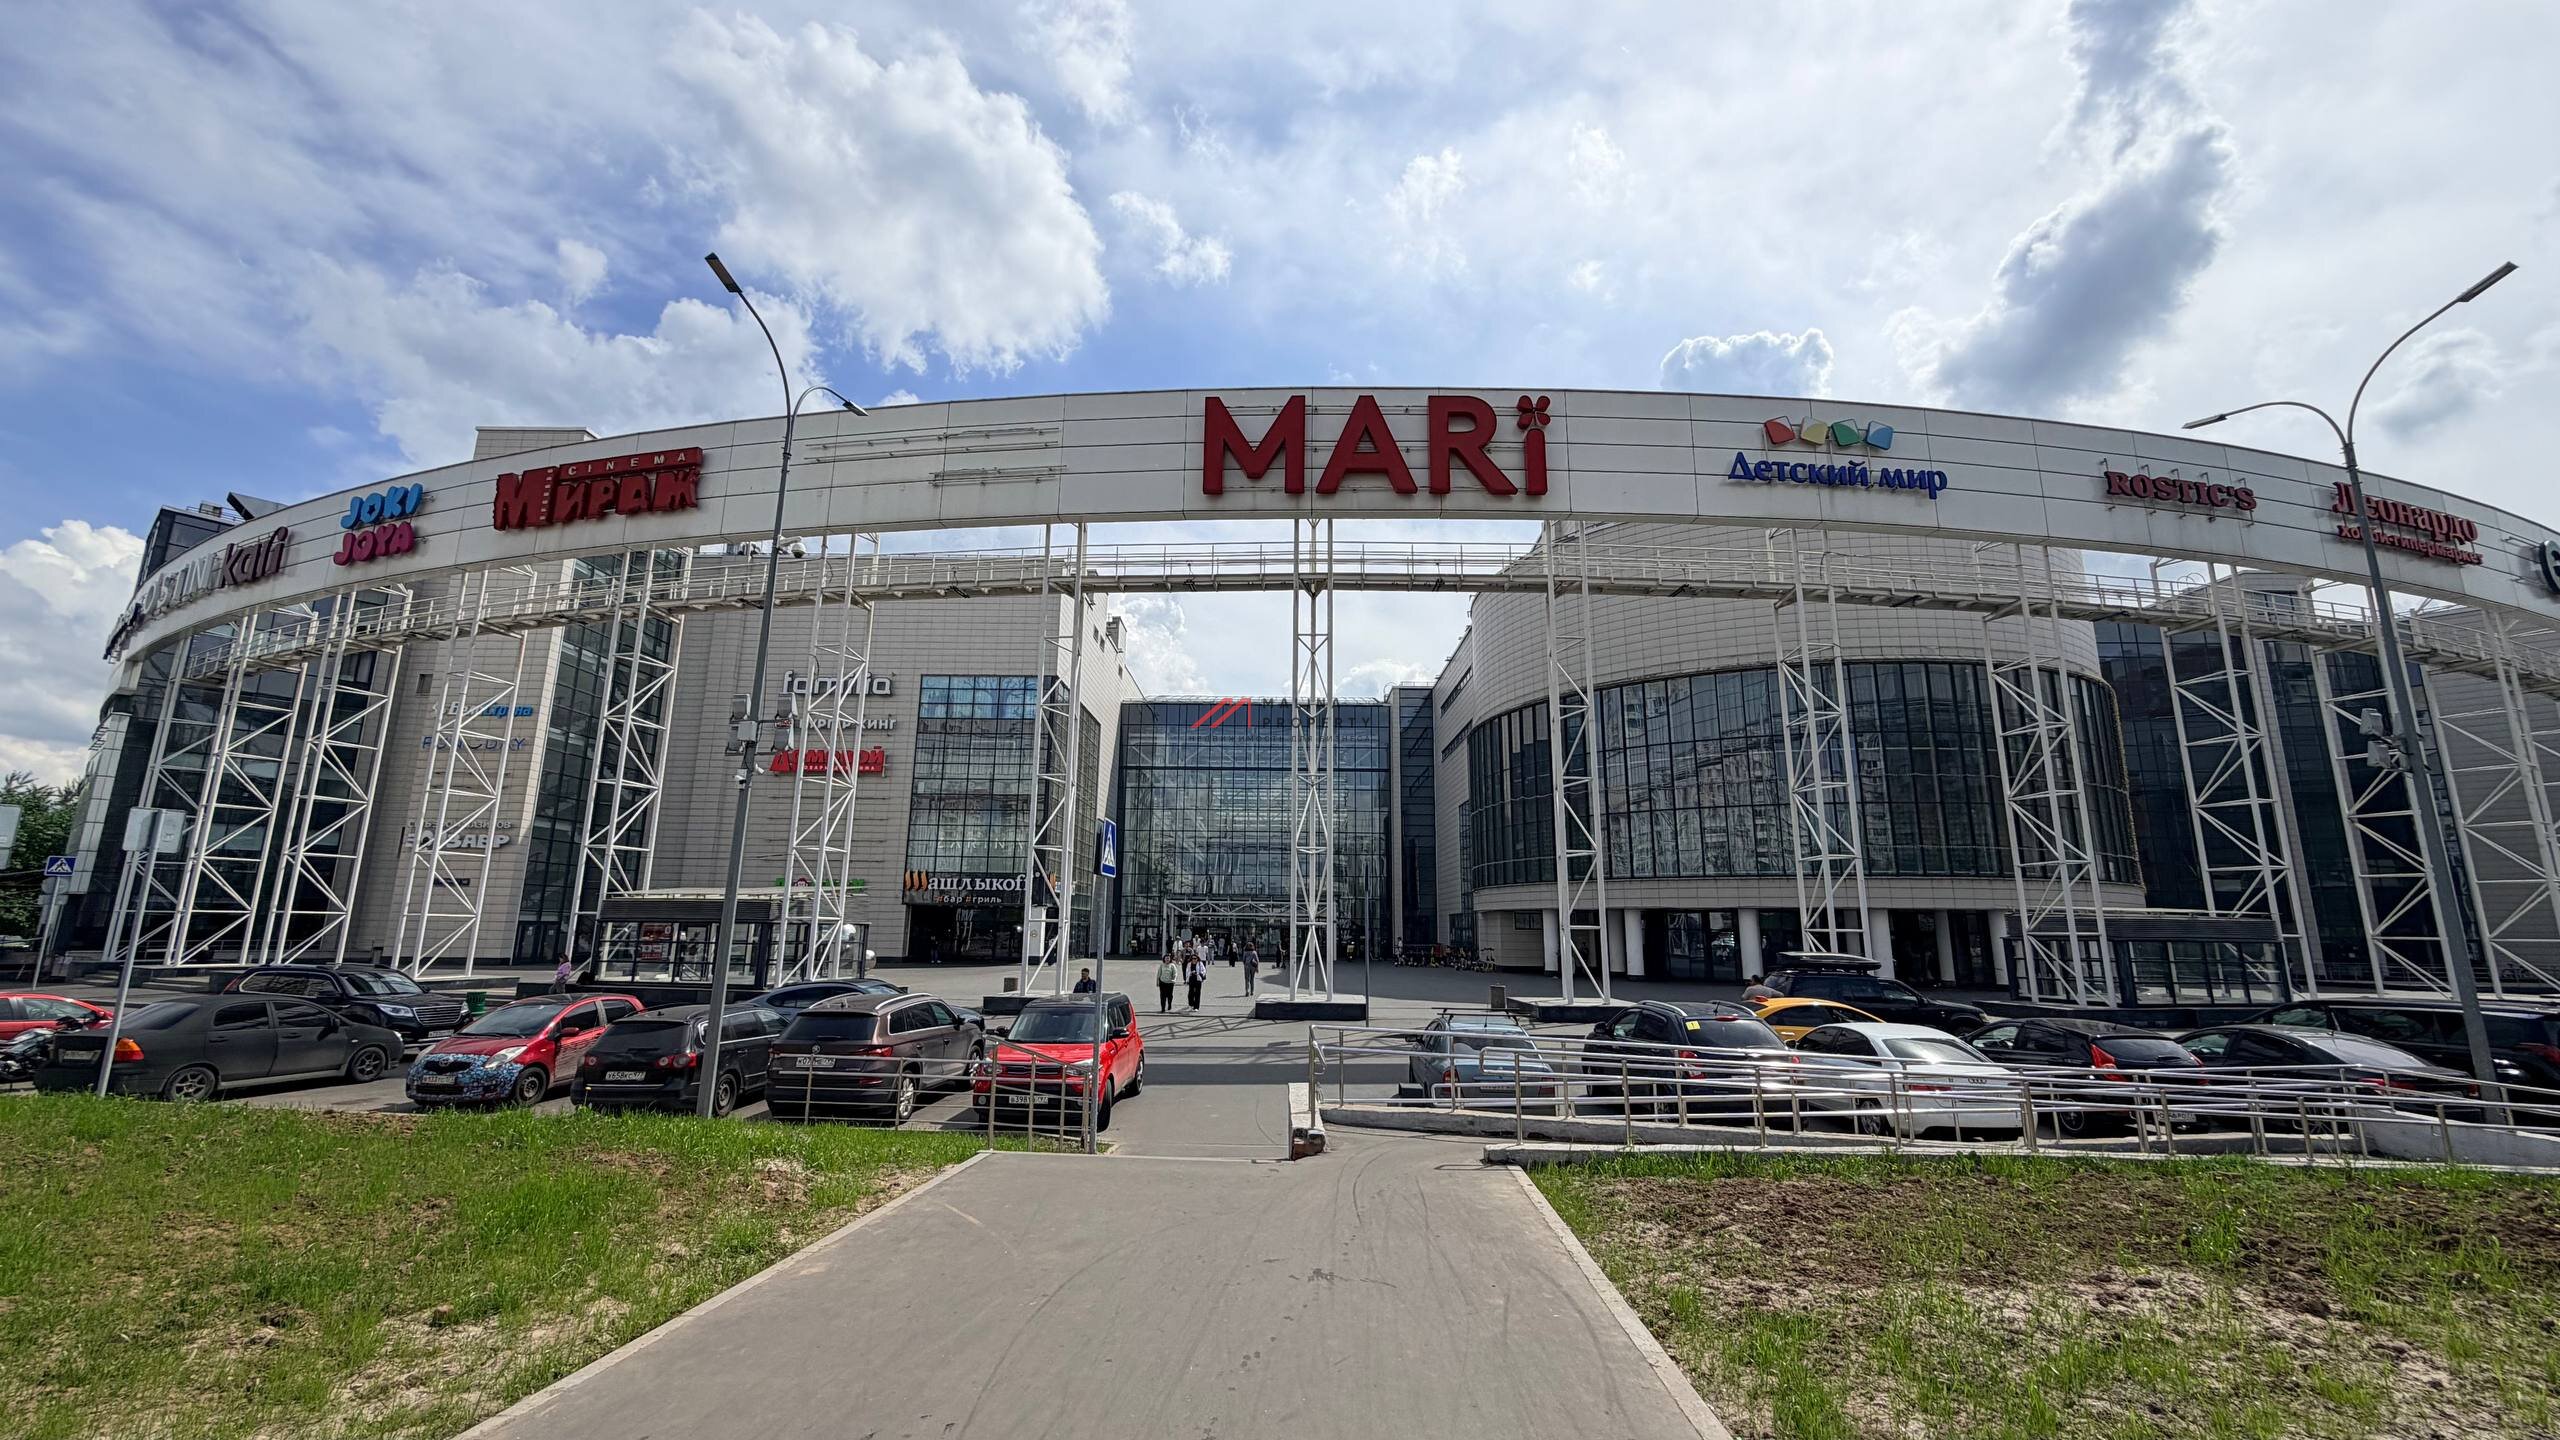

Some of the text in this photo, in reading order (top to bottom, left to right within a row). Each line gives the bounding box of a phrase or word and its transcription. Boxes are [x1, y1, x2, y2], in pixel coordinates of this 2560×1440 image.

[567, 452, 687, 476] CINEMA
[1728, 451, 1948, 500] Детский мир
[340, 483, 423, 529] JOKI
[2104, 470, 2257, 511] ROSTIC'S
[2332, 481, 2479, 546] Леонардо
[333, 521, 414, 566] JOYA
